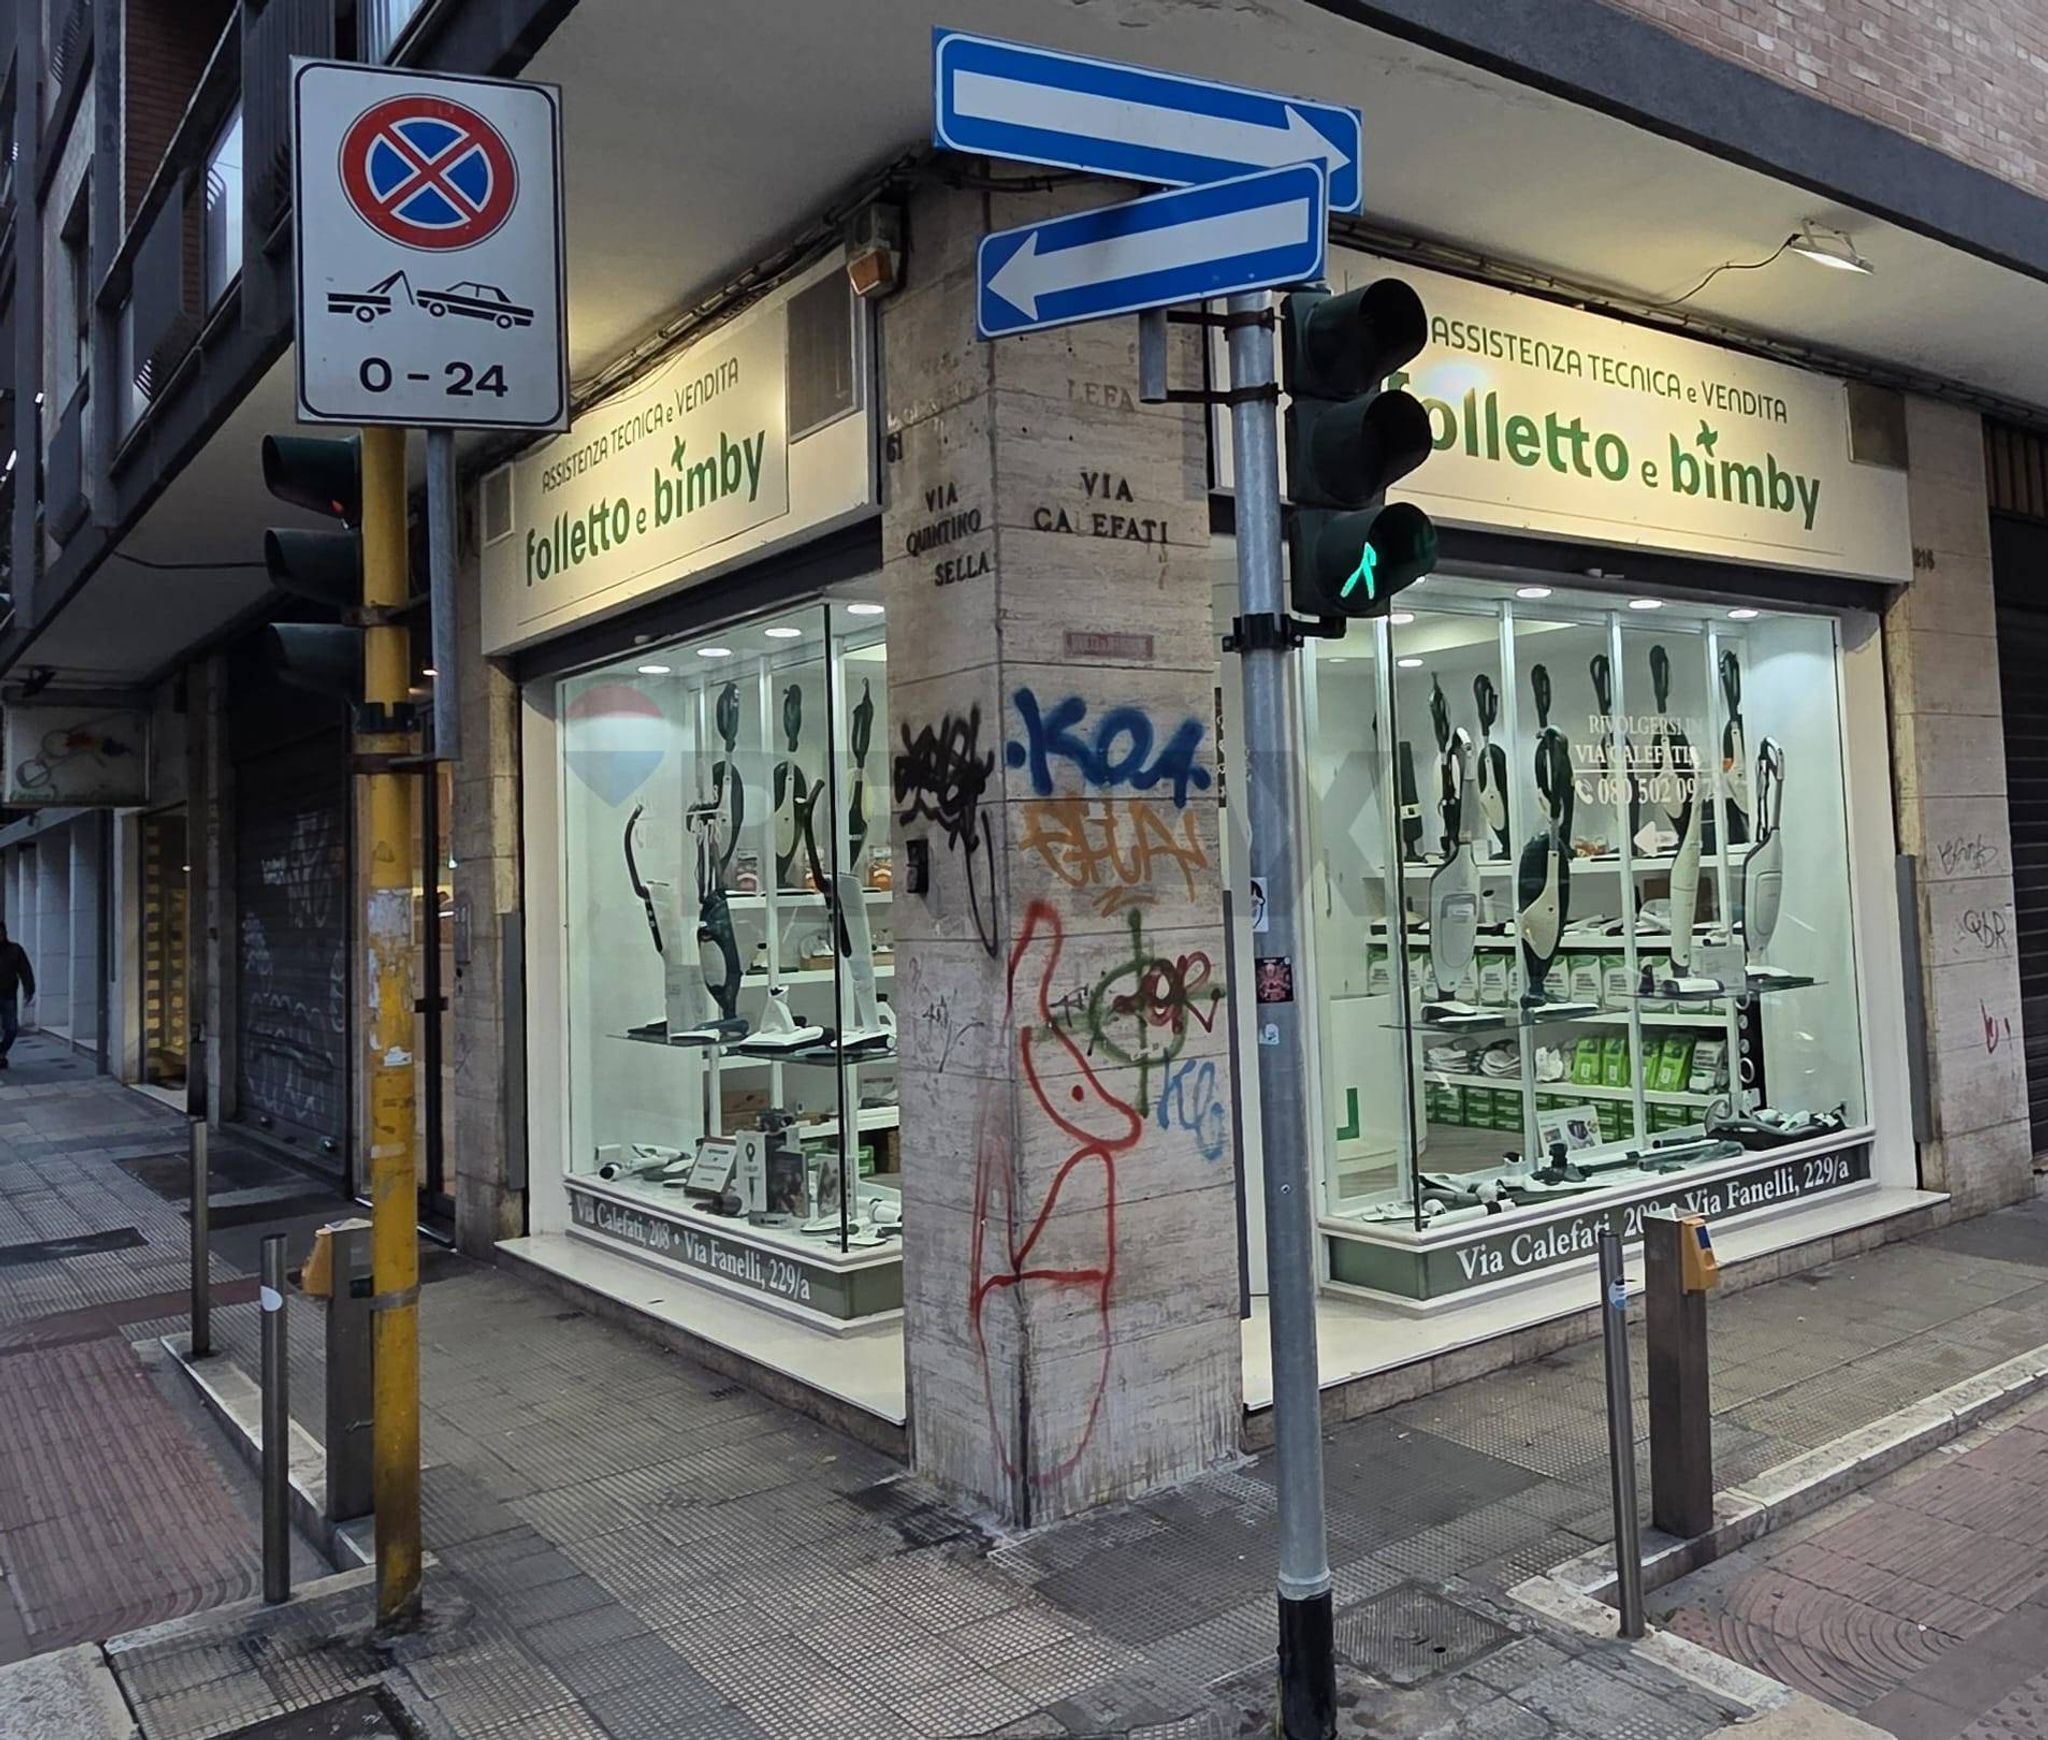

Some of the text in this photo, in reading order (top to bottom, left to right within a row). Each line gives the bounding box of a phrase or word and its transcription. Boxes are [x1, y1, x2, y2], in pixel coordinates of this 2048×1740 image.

[1431, 316, 1788, 423] ASSISTENZA TECNICA e VENDITA
[542, 357, 739, 494] ASSISTENZA TECNICA e VENDITA
[525, 429, 766, 587] folletto e bimby
[925, 482, 959, 513] VIA
[1080, 471, 1134, 503] VIA
[1641, 458, 1658, 488] e
[1669, 419, 1820, 531] bimby
[906, 508, 982, 557] QUINTINO
[935, 551, 990, 587] SELLA
[1575, 744, 1606, 763] VIA
[1638, 777, 1671, 804] 502
[576, 1194, 810, 1300] Via Calefati, 208 Via Fanelli, 229/a
[1456, 1249, 1504, 1280] Via
[1624, 1201, 1660, 1237] 20
[1685, 1189, 1722, 1216] Via
[1725, 1166, 1801, 1210] Fanelli,
[1802, 1153, 1850, 1189] 229/a
